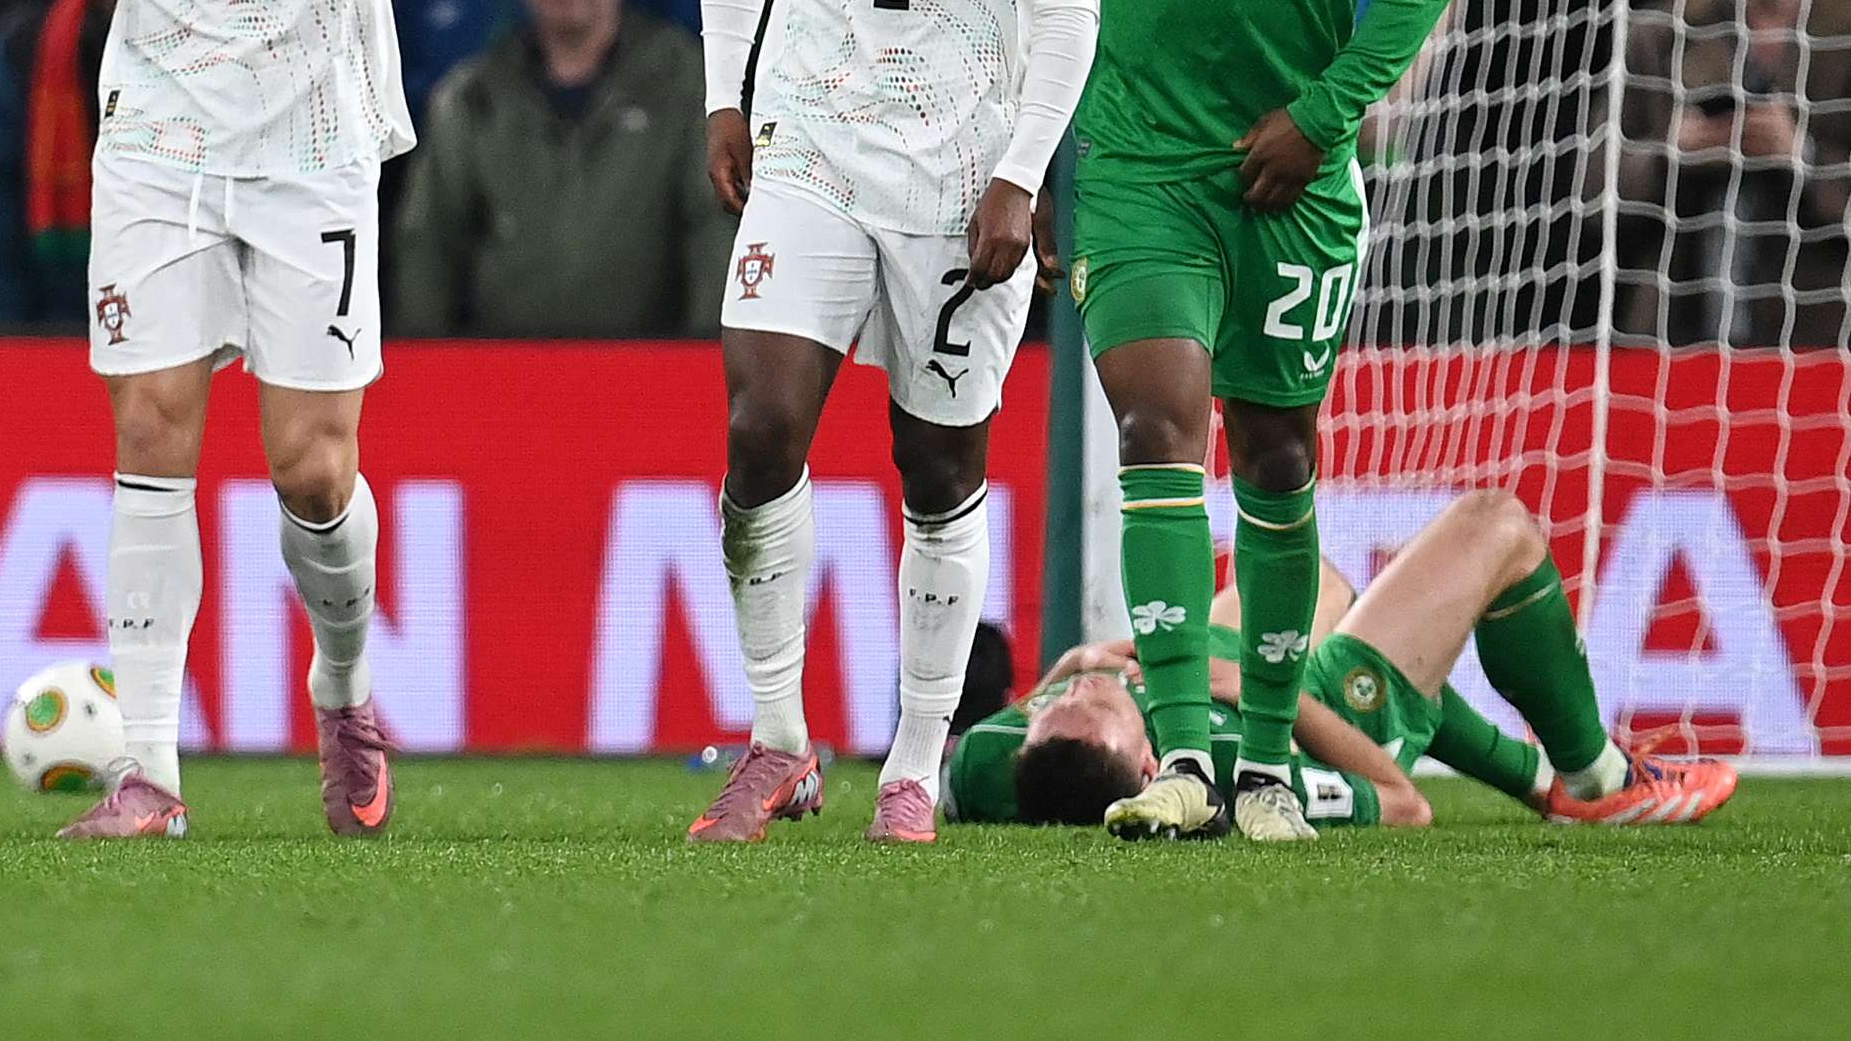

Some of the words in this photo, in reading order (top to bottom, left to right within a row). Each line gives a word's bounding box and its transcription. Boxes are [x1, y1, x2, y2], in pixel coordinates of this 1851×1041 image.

[320, 227, 356, 317] 7
[933, 268, 976, 357] 2
[1262, 261, 1353, 342] 20
